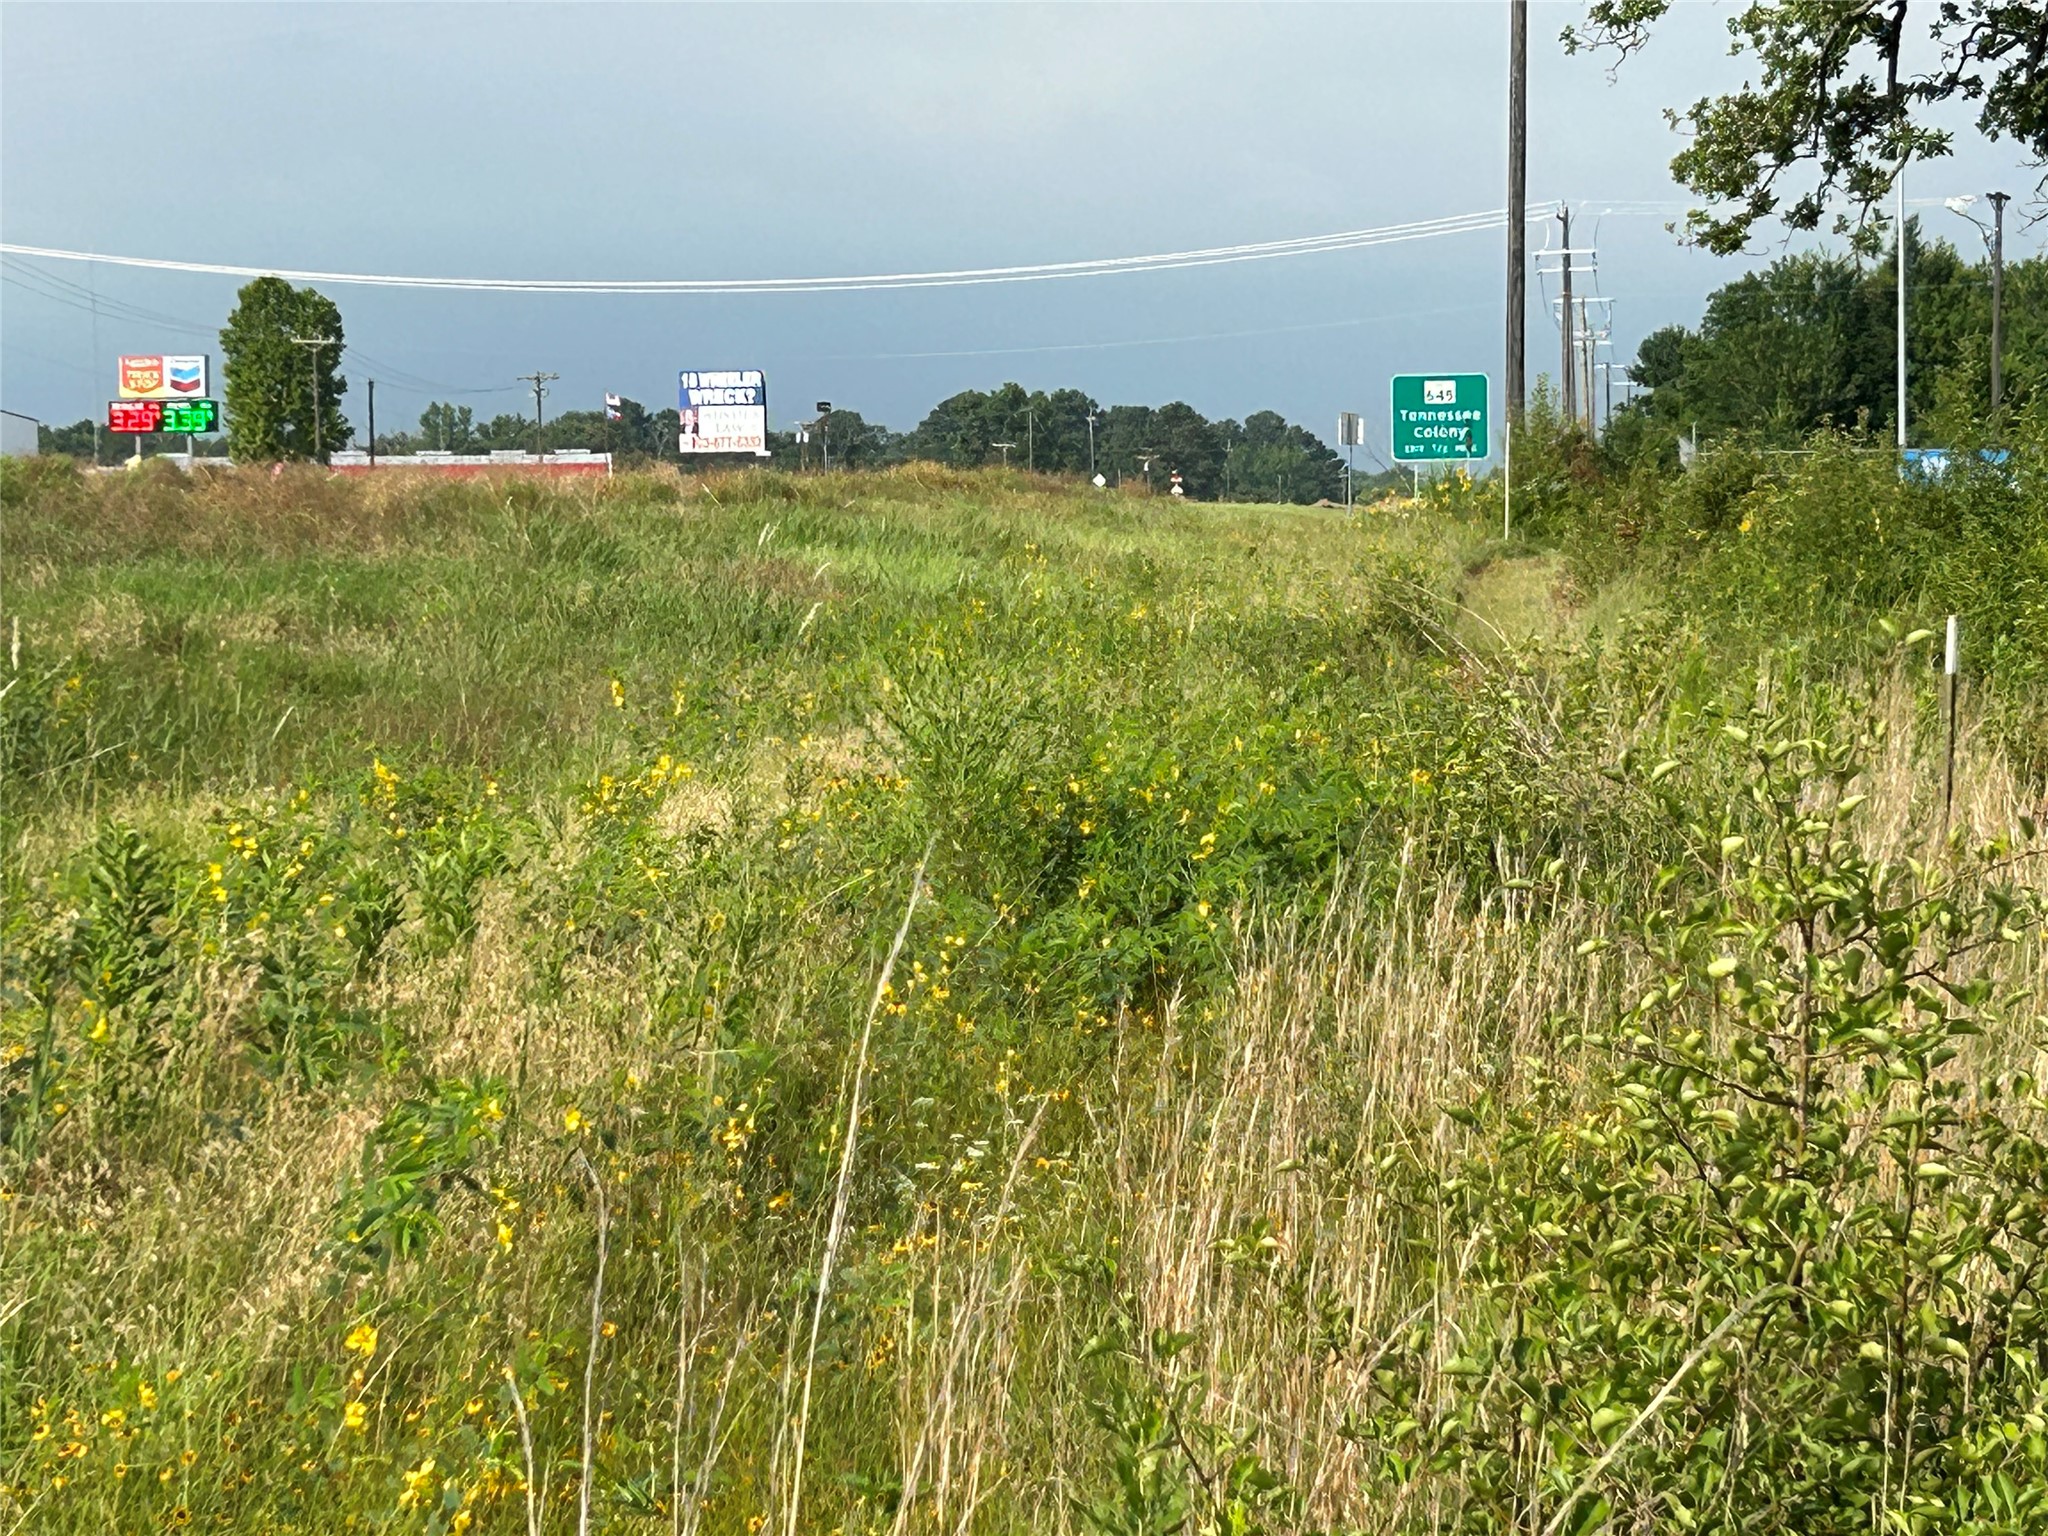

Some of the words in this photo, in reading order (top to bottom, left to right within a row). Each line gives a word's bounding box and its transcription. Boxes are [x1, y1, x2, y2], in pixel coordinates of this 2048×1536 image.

[698, 372, 762, 387] WHEELER
[689, 388, 756, 405] WRECK?
[1426, 390, 1453, 402] 645
[1399, 409, 1482, 422] Tennessee
[1413, 424, 1470, 441] Colony
